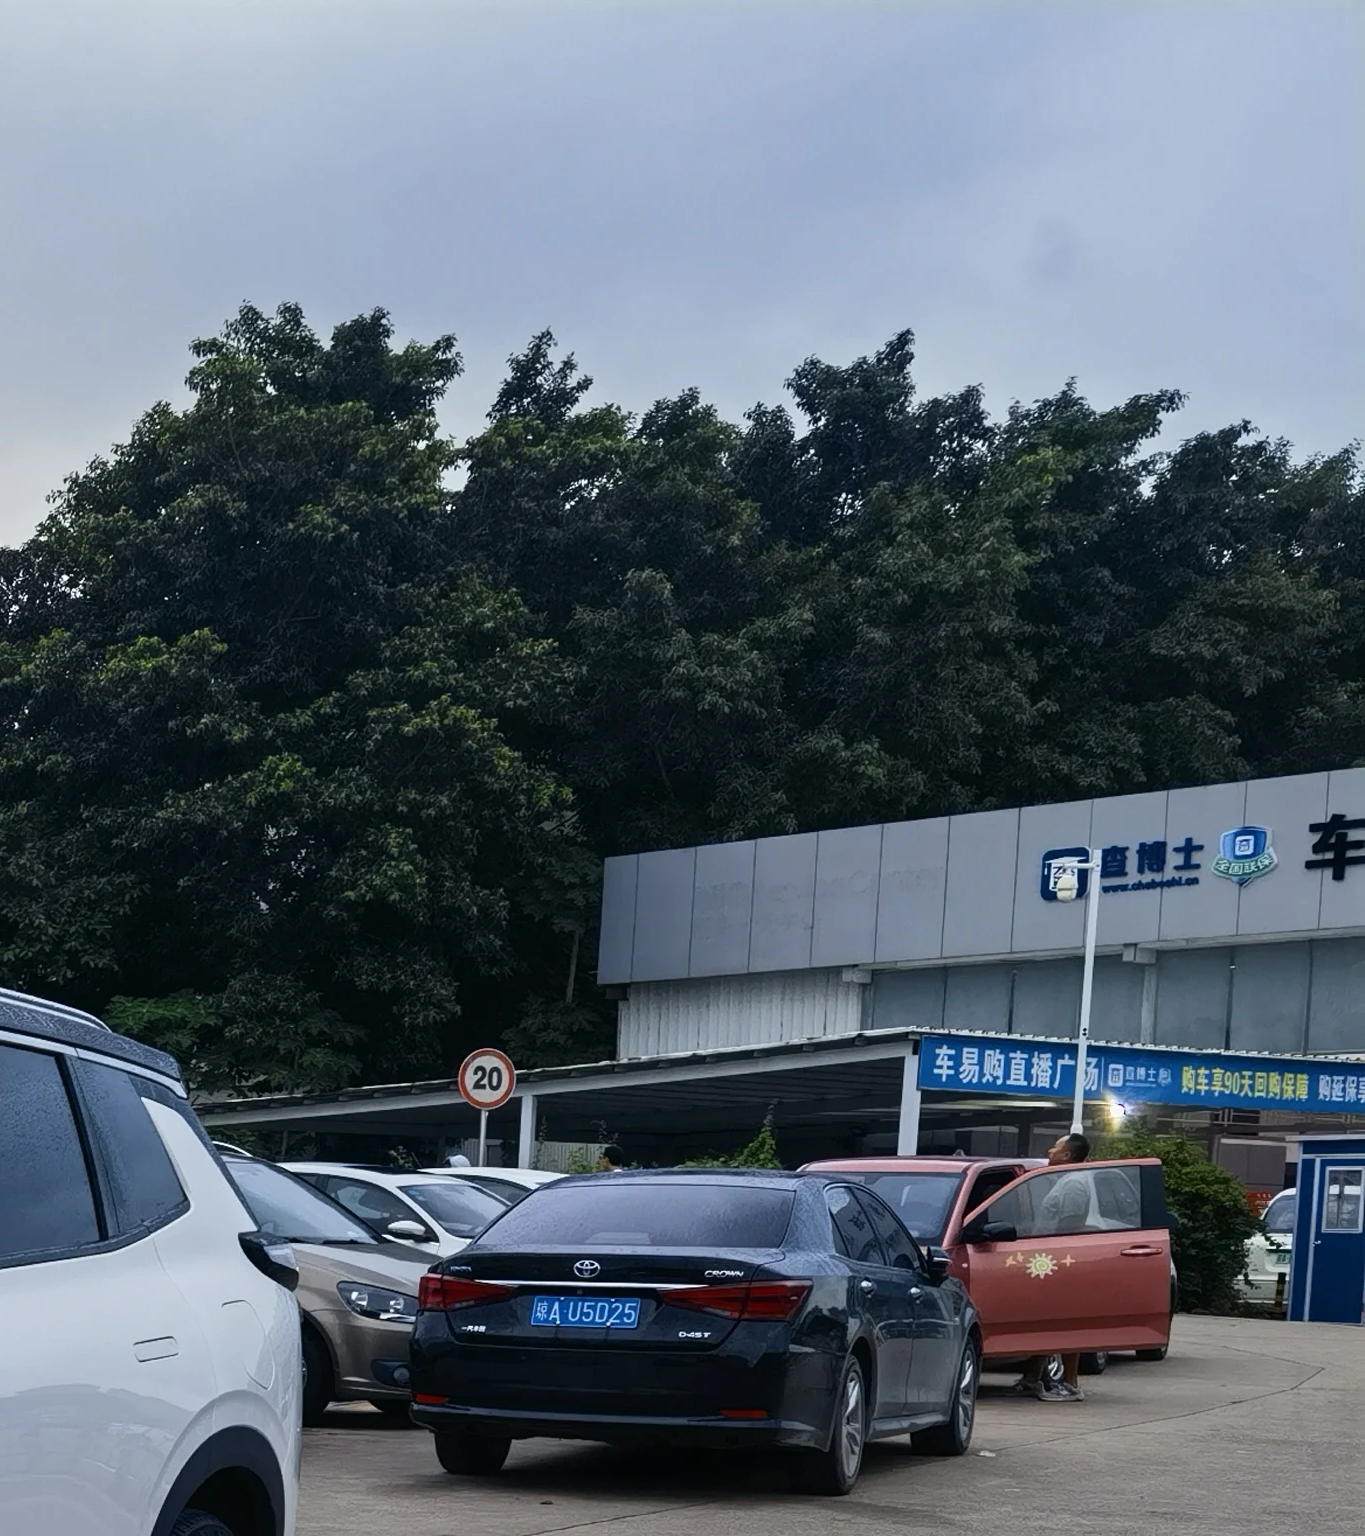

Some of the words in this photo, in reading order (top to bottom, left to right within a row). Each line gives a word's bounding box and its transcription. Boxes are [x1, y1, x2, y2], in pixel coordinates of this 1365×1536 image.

[1100, 837, 1205, 879] 查博士
[472, 1065, 503, 1091] 20
[704, 1270, 744, 1278] CROWN
